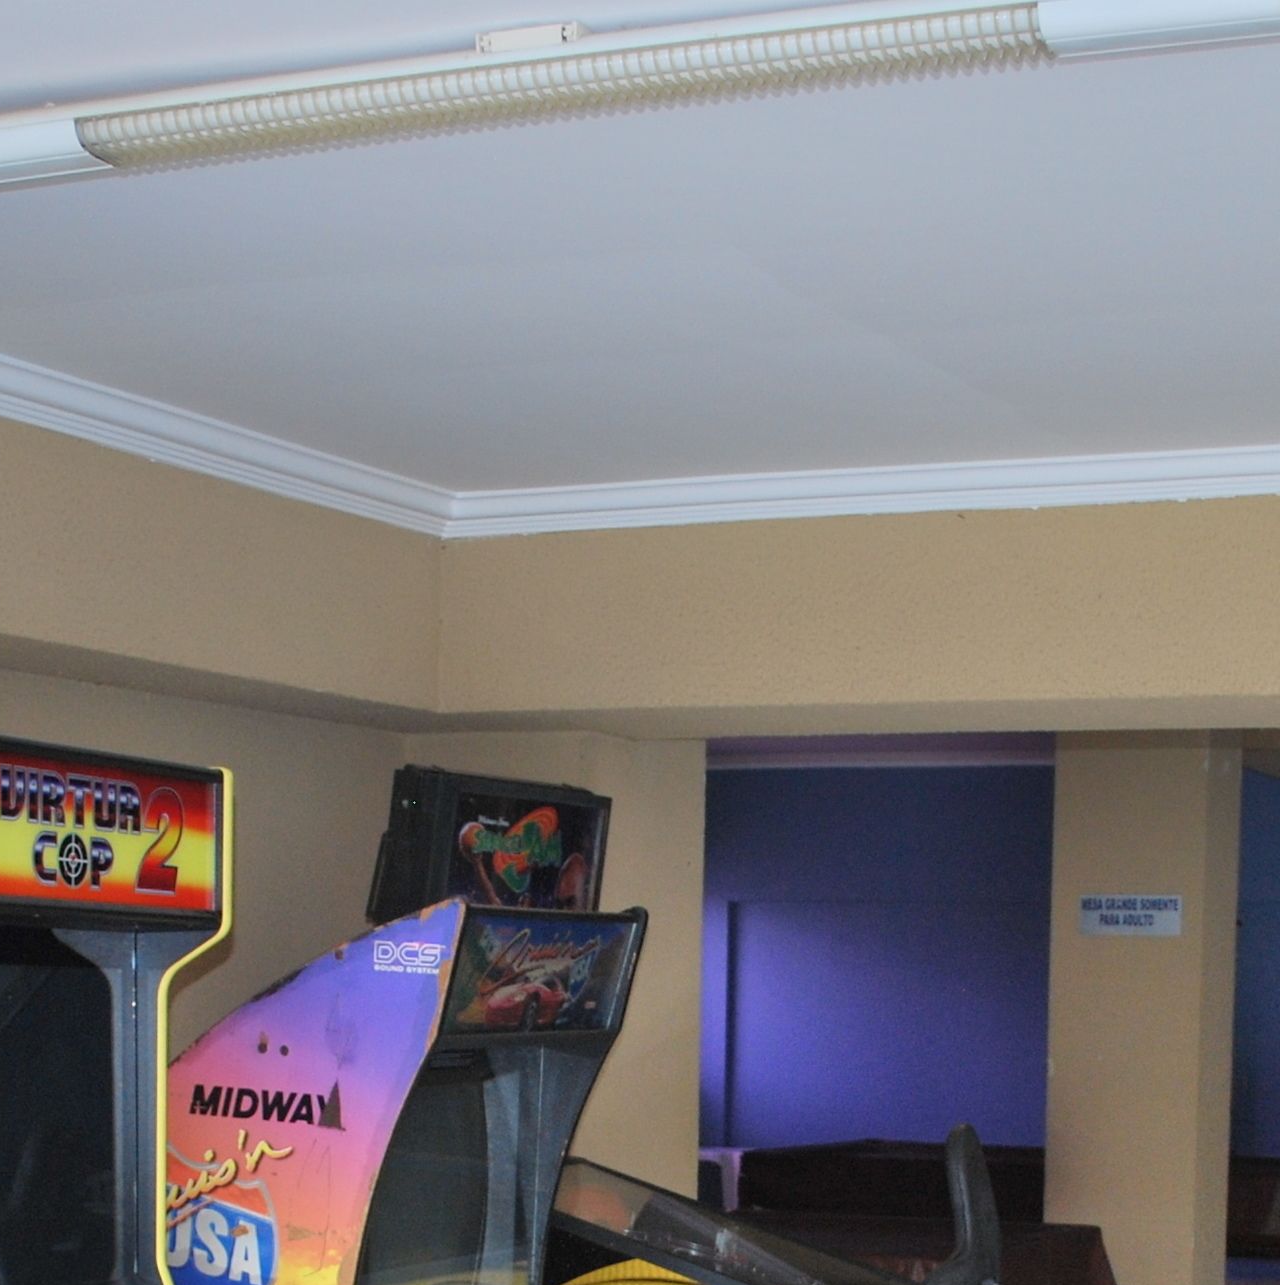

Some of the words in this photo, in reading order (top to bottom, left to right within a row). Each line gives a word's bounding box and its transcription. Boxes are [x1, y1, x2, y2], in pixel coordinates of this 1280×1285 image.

[32, 830, 115, 891] COP
[134, 785, 186, 897] 2
[373, 940, 440, 967] DCS
[165, 1128, 294, 1213] uis'n
